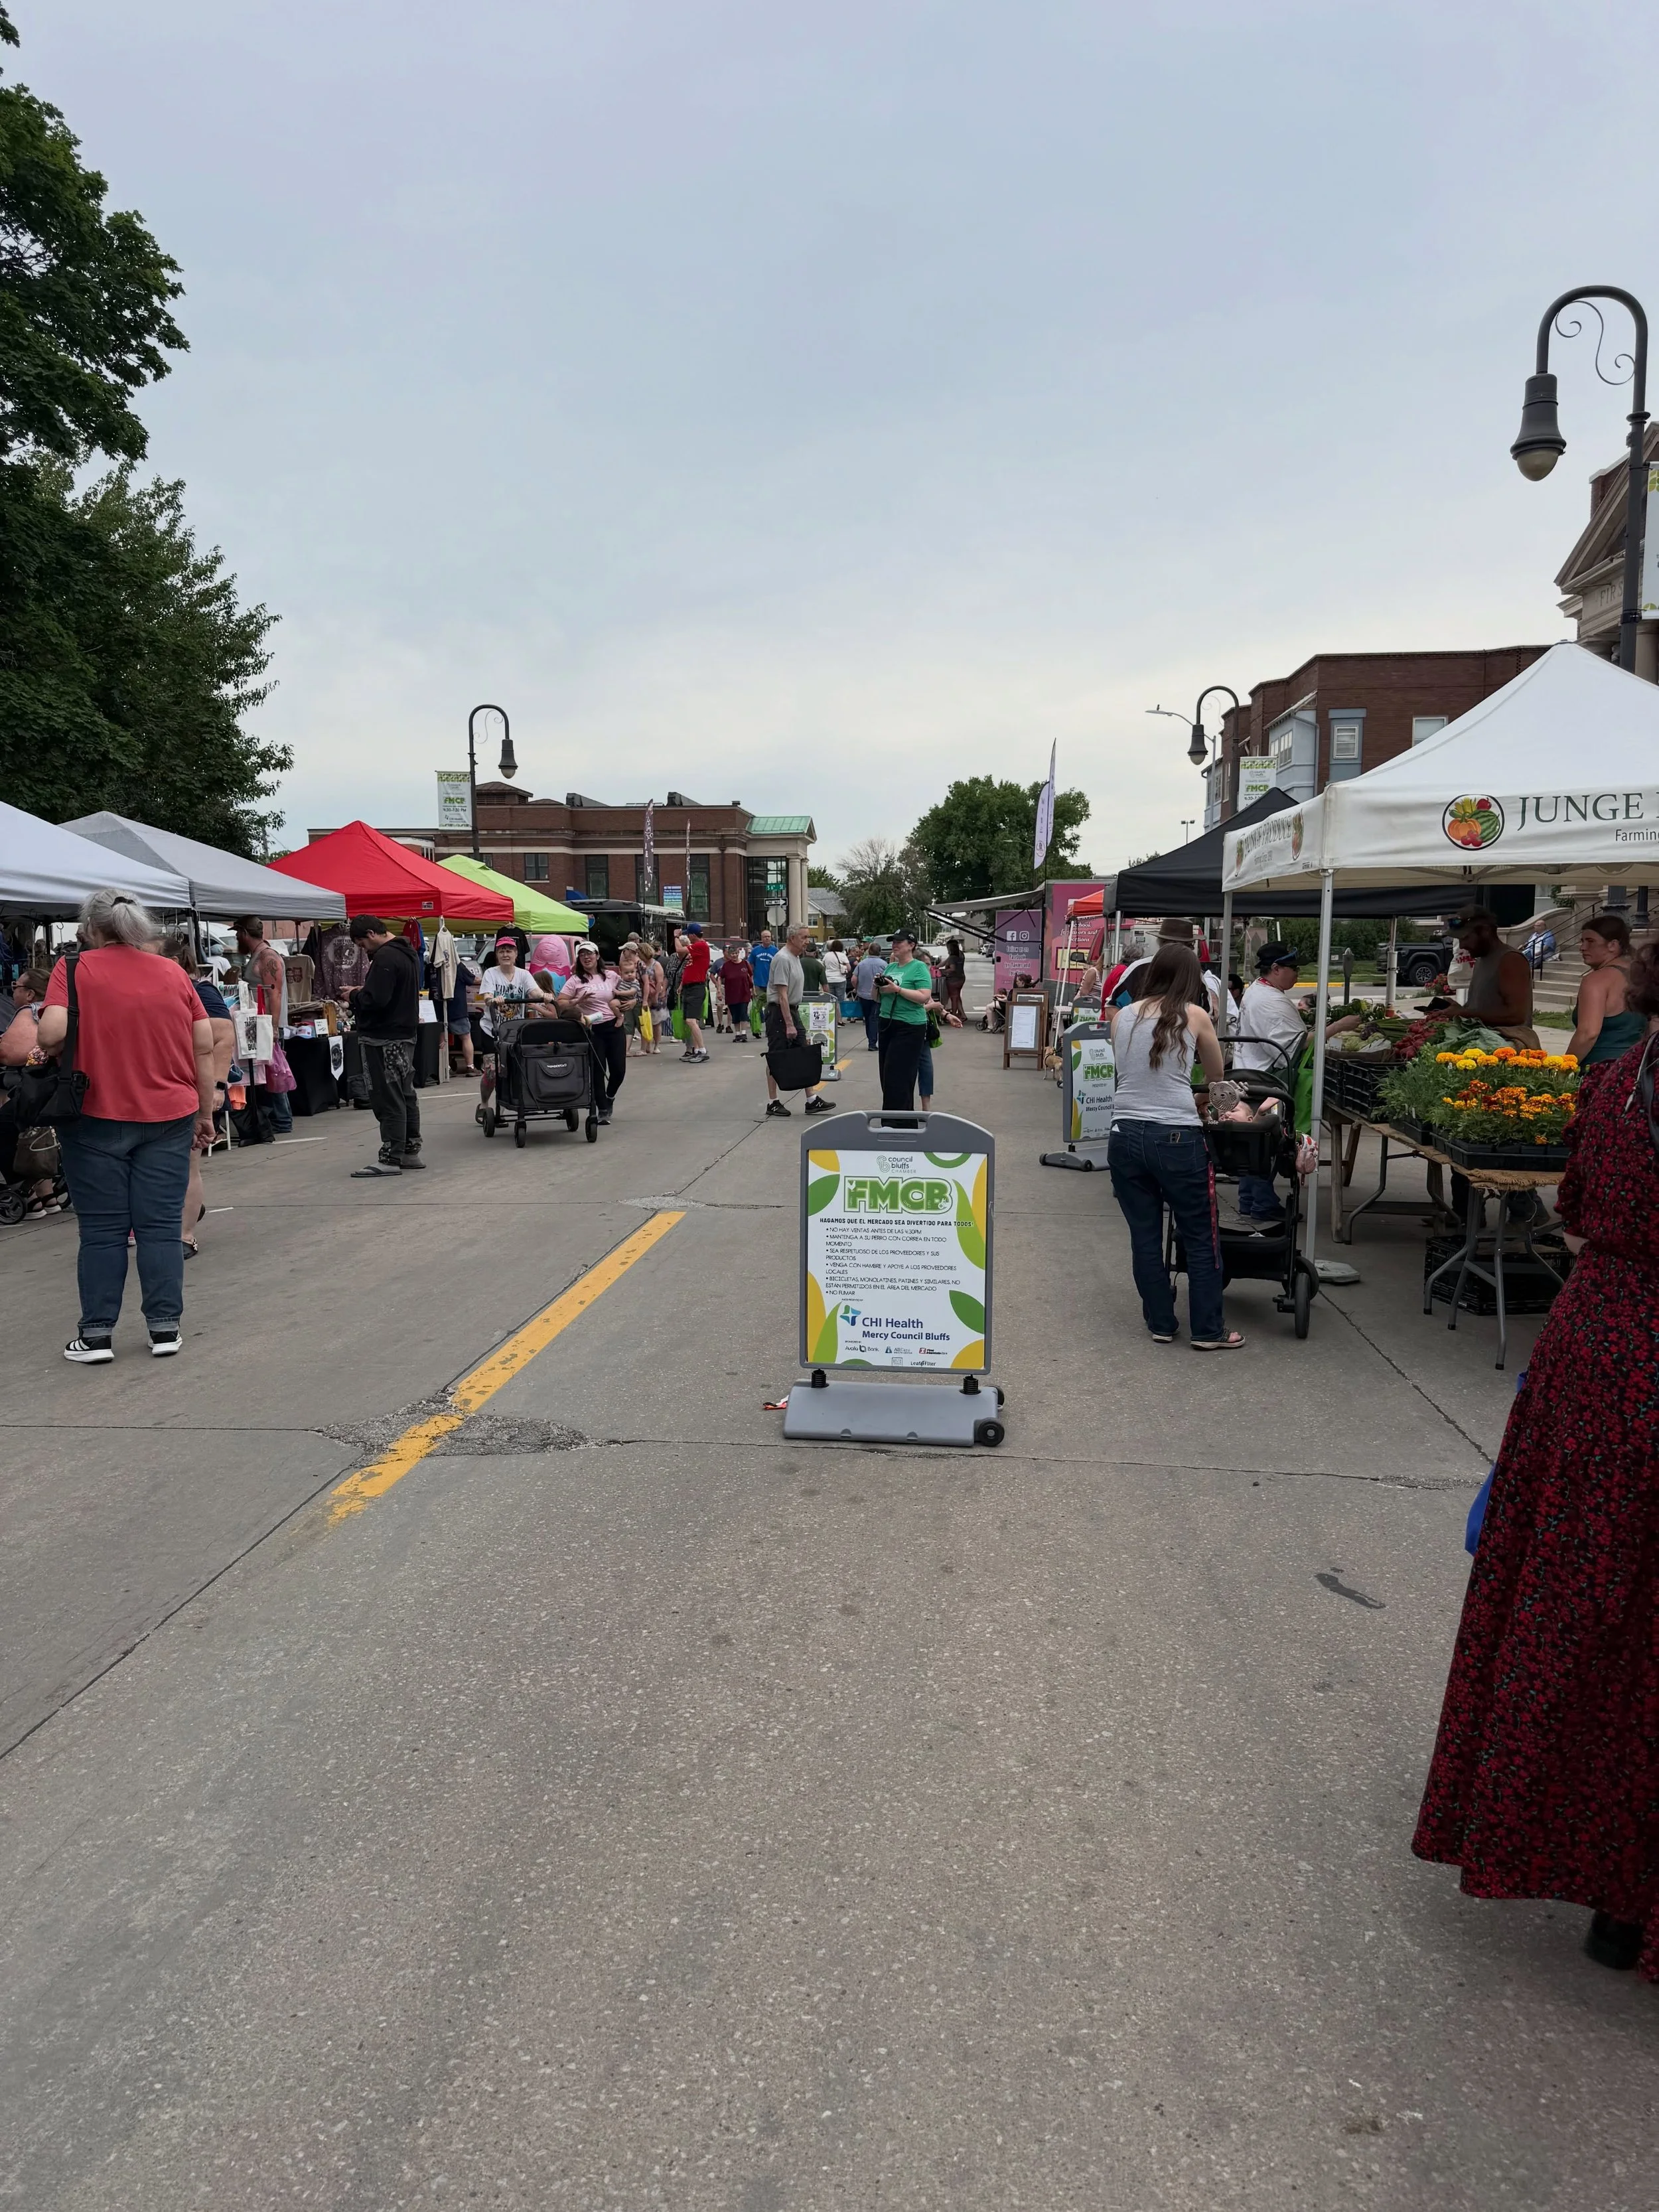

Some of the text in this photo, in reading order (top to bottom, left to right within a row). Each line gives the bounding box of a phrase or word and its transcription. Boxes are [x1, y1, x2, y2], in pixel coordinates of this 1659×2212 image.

[1600, 581, 1624, 607] FIRS
[1518, 792, 1644, 831] JUNGE
[1084, 1063, 1114, 1080] FMCB
[845, 1177, 951, 1213] FMCB
[862, 1317, 924, 1329] CHI Health
[862, 1330, 950, 1341] Mercy Council Bluffs
